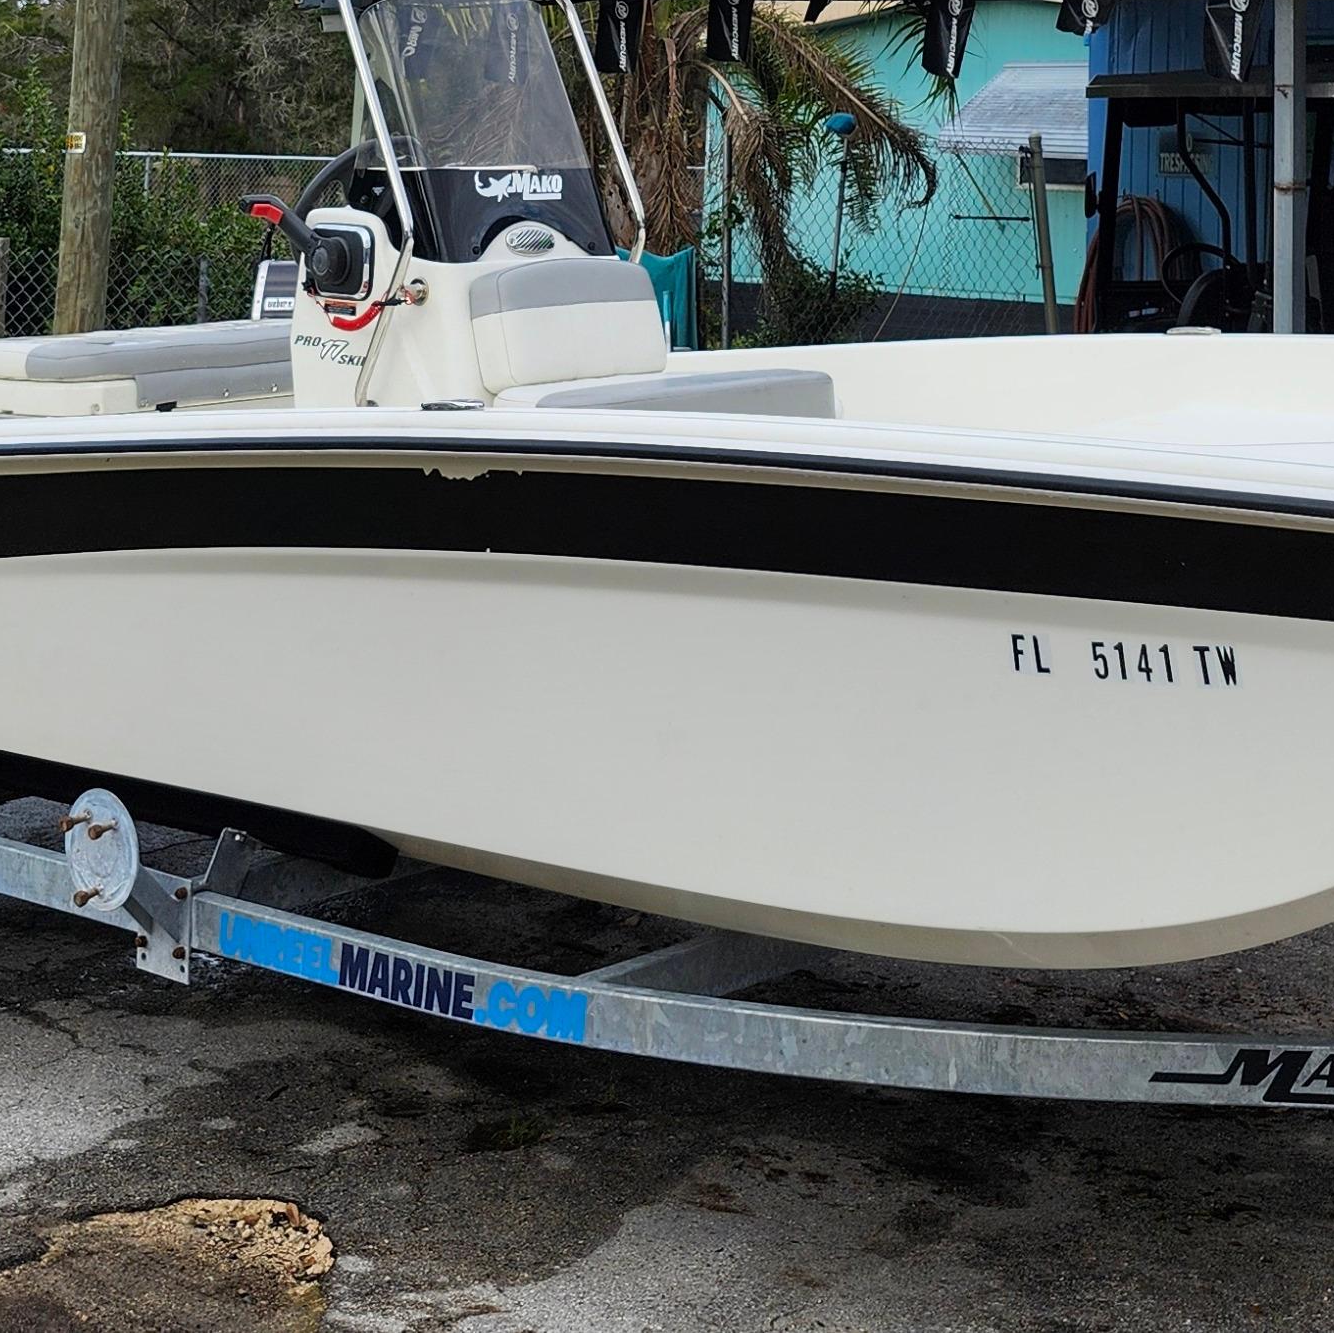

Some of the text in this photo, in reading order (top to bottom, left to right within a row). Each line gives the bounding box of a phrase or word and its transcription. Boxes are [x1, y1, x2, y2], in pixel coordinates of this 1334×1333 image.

[507, 32, 519, 83] MERCURY
[618, 20, 628, 73] MERCURY
[730, 6, 741, 61] MERCURY
[945, 16, 959, 78] MERCURY
[1229, 12, 1244, 82] MERCURY
[507, 171, 563, 200] MAKO
[294, 334, 322, 347] PRO
[319, 338, 350, 362] 17
[1010, 633, 1238, 686] FL 5141 TW
